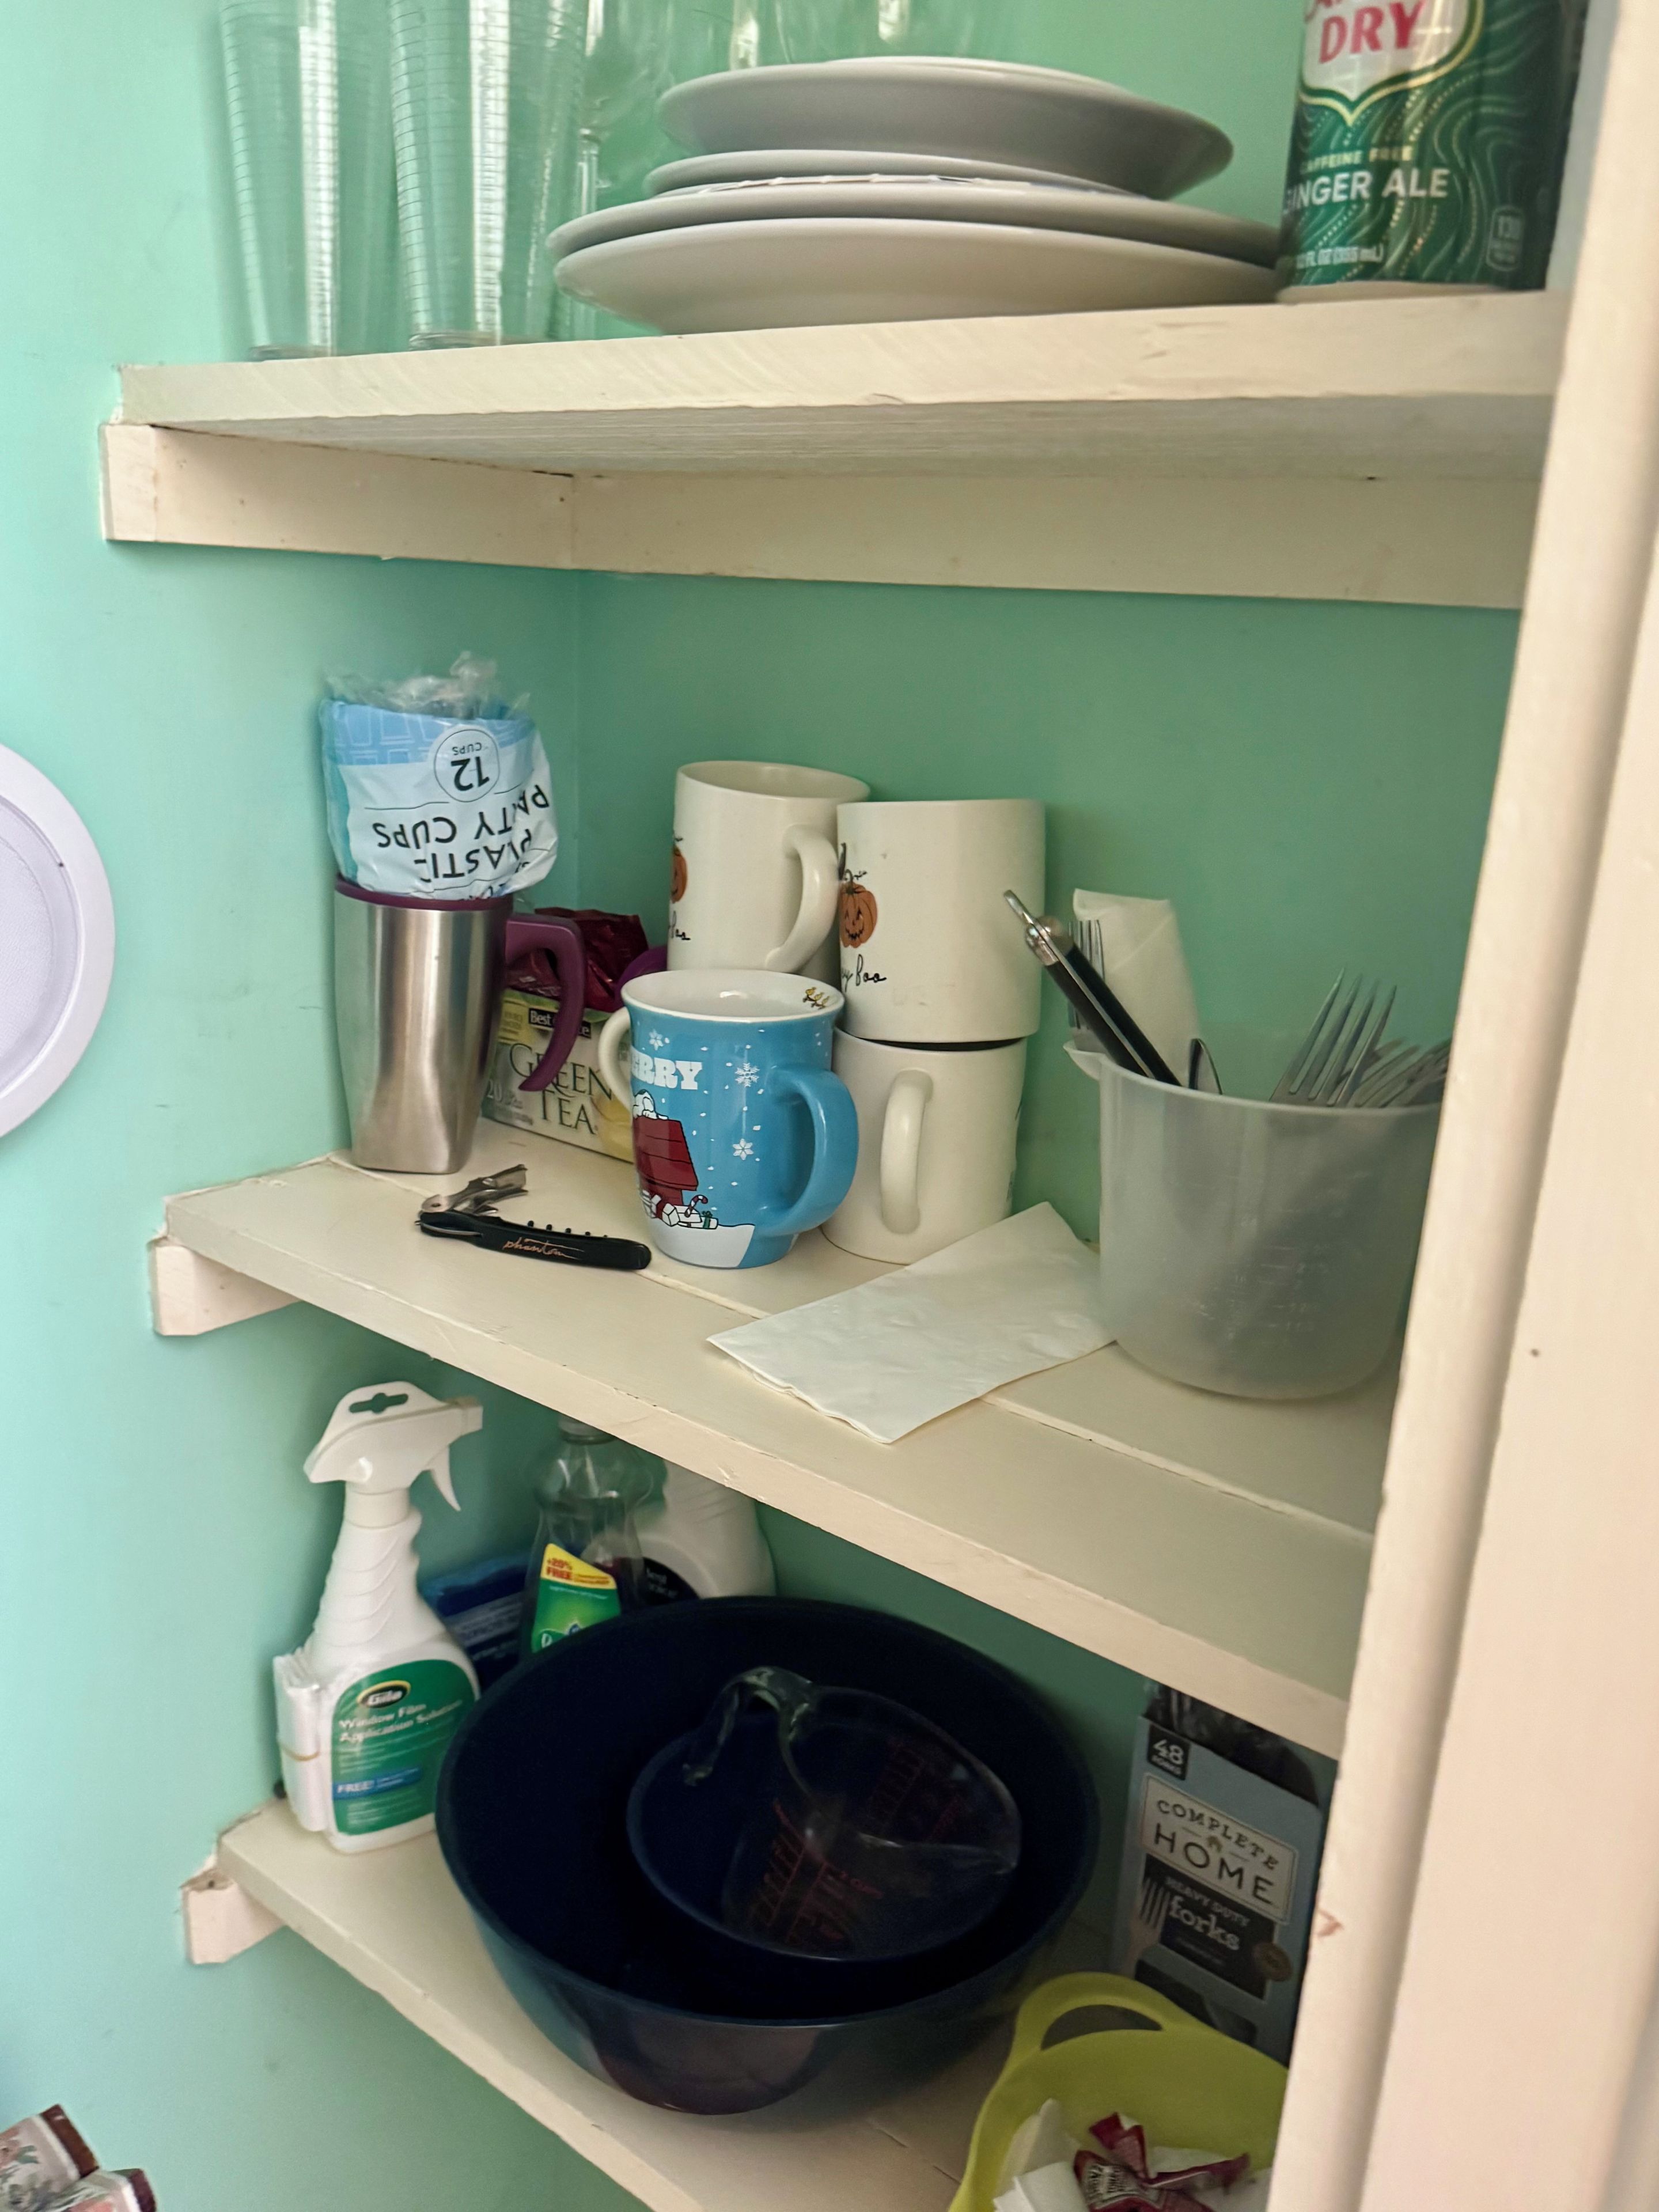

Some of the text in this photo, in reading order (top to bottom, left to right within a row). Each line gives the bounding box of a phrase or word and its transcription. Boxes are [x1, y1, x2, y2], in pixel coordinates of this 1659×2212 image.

[1319, 0, 1427, 64] DRY
[1381, 168, 1449, 198] ALE
[452, 742, 482, 756] CUPS
[450, 756, 490, 791] 12
[372, 816, 457, 850] CUPS
[530, 1009, 552, 1027] Best
[541, 1089, 597, 1135] TEA
[502, 1237, 583, 1260] phantom
[339, 1713, 395, 1729] Window
[1153, 1739, 1184, 1764] 48
[1157, 1800, 1279, 1870] COMPLETE
[1154, 1823, 1275, 1904] HOME
[1169, 1895, 1241, 1950] forks
